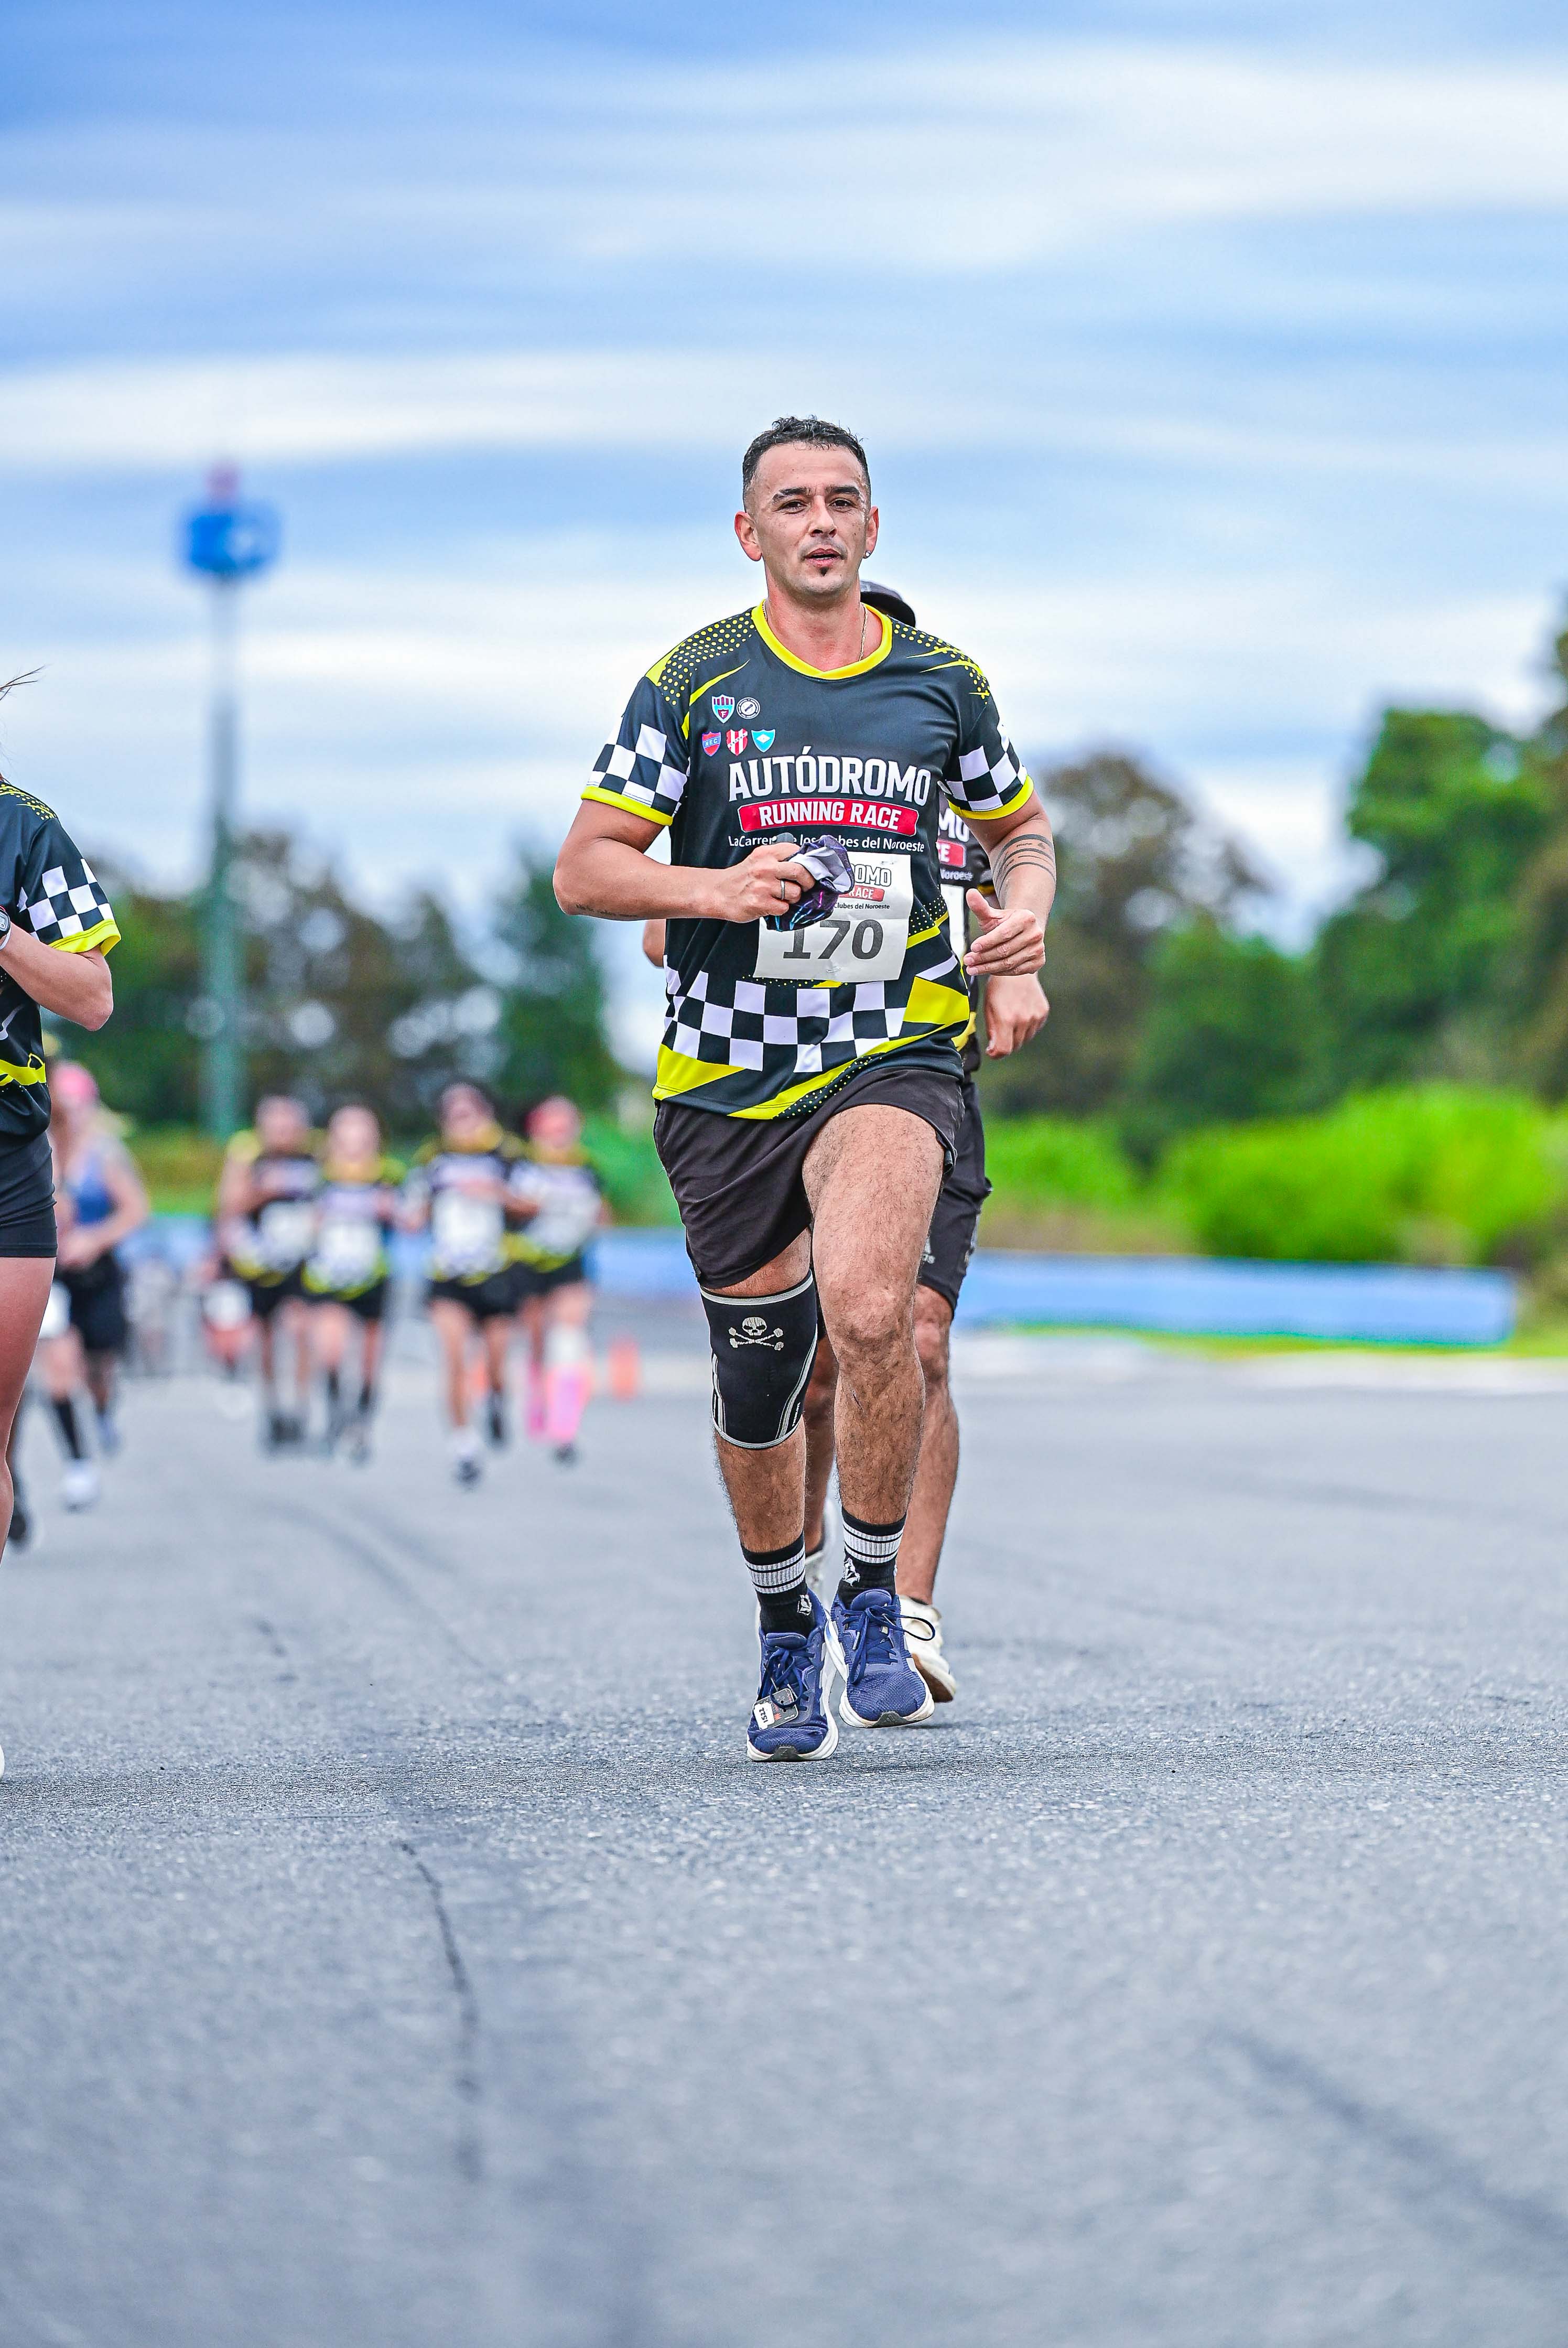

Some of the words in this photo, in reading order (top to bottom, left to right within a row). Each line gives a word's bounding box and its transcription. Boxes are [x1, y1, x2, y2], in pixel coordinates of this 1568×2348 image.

[728, 746, 932, 806] AUTÓDROMO
[758, 801, 845, 827] RUNNING
[849, 802, 902, 830] RACE
[861, 836, 880, 849] del
[883, 838, 924, 852] Noroeste
[783, 919, 884, 960] 170
[759, 1707, 769, 1724] 1522
